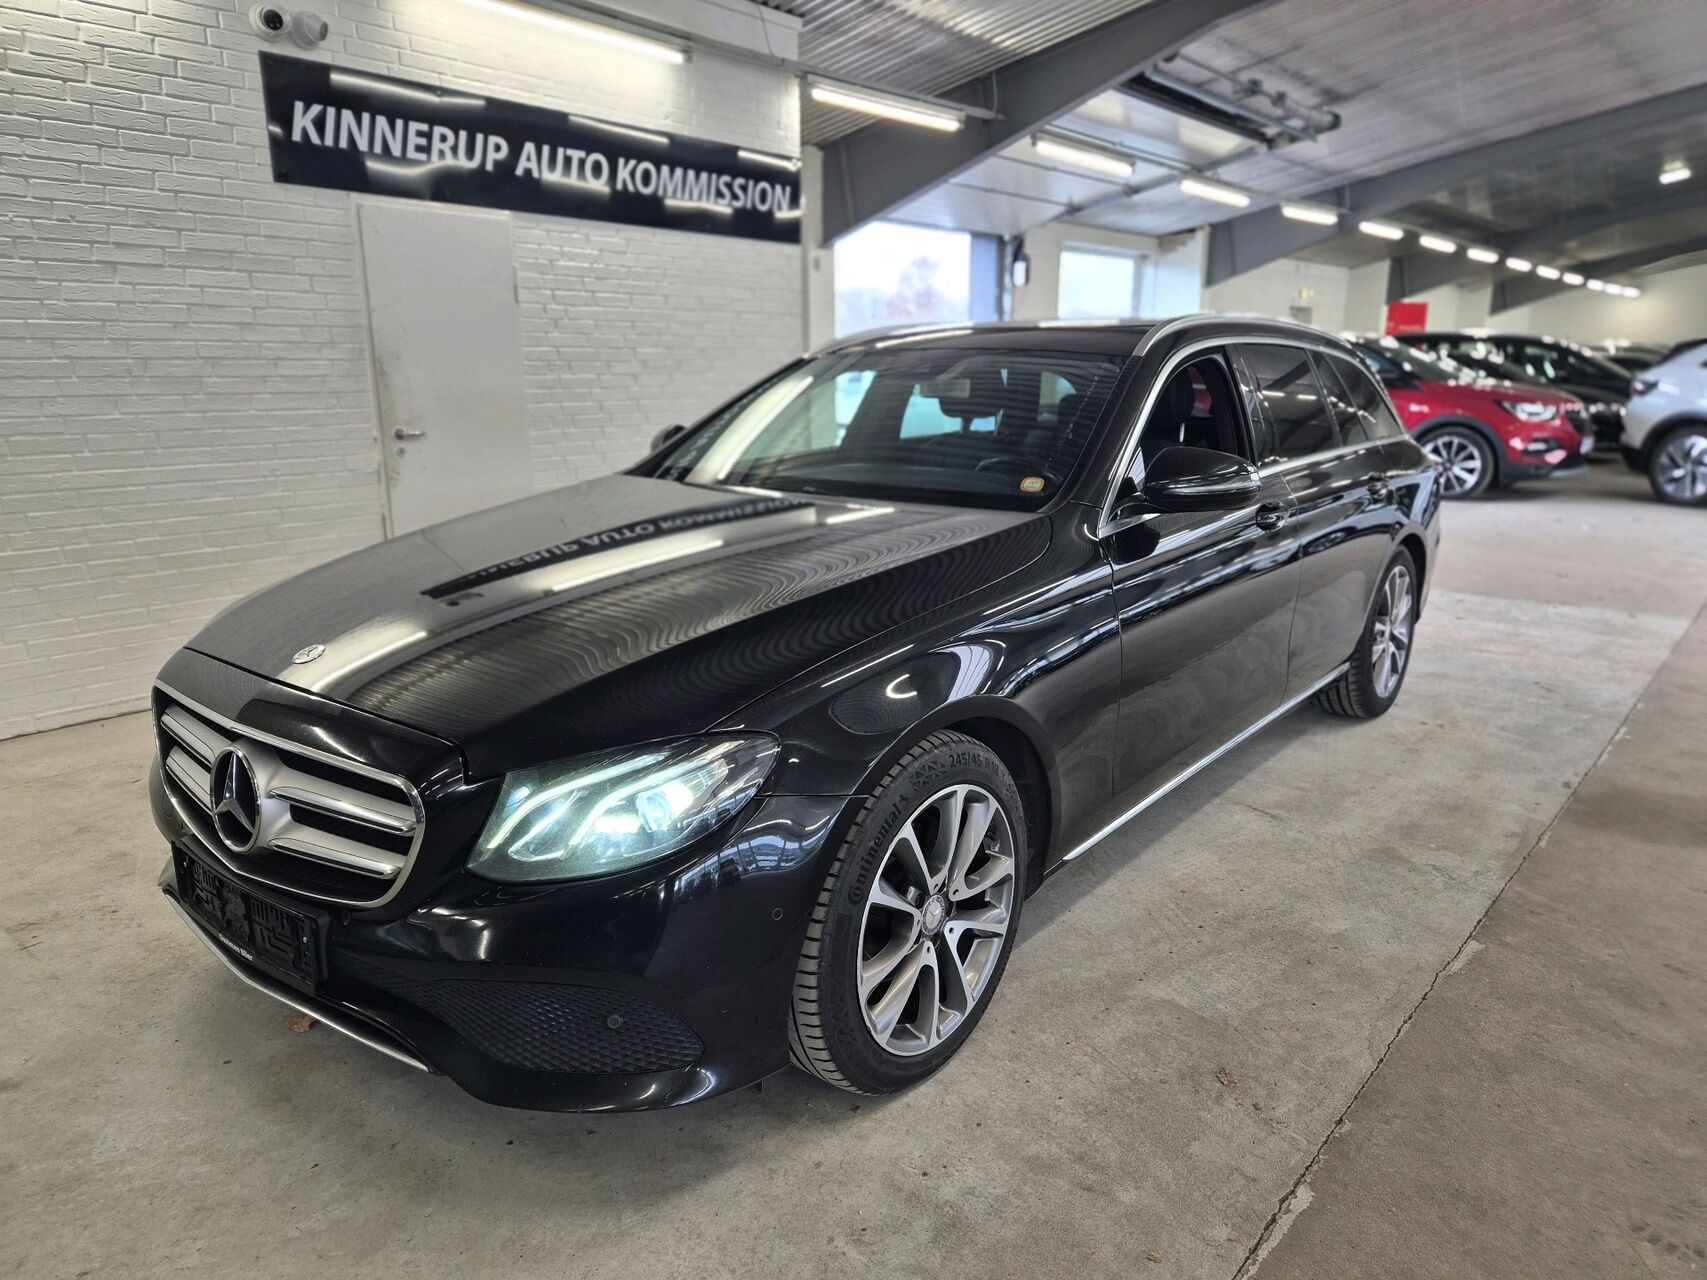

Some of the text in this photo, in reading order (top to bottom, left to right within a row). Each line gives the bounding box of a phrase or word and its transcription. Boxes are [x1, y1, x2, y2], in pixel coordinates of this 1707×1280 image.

[291, 100, 791, 212] KINNERUP AUTO KOMMISSION
[949, 752, 982, 768] 245/45
[847, 802, 902, 905] Continental
